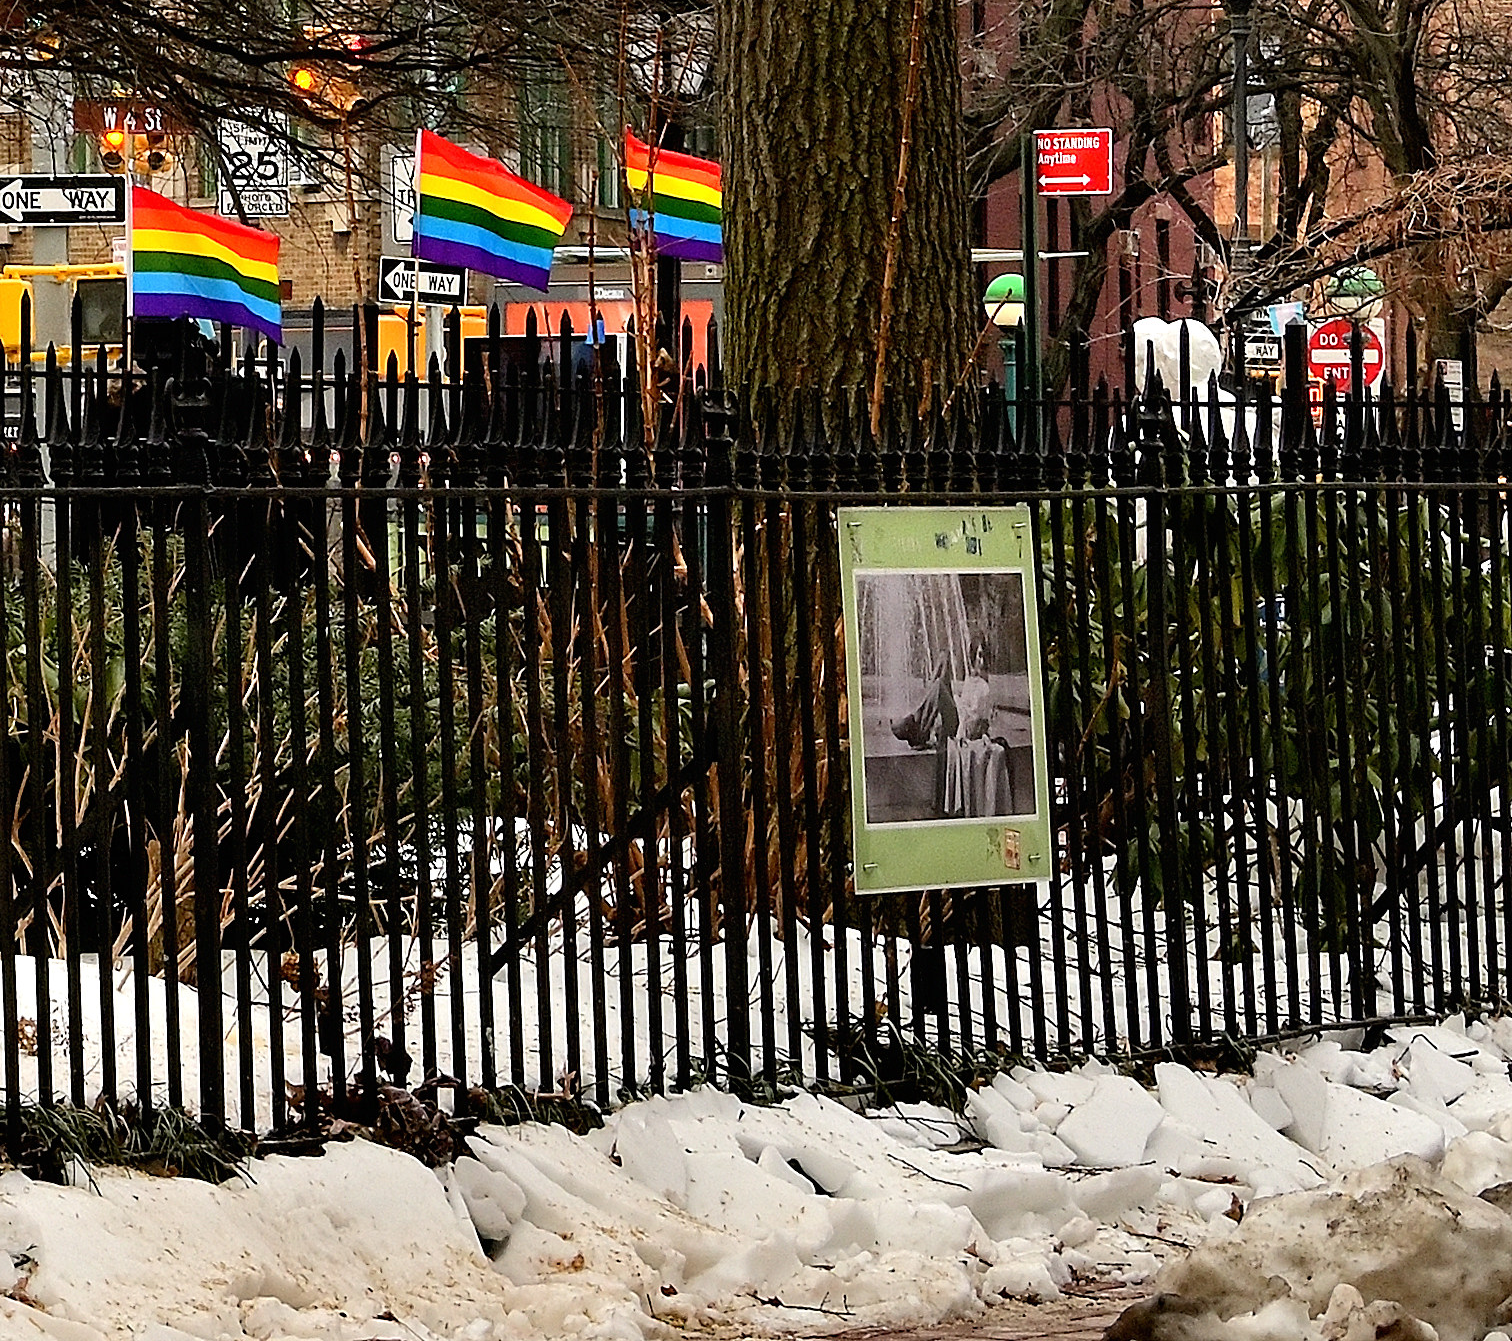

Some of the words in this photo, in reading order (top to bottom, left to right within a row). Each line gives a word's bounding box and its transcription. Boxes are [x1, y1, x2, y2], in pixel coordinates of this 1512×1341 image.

[103, 107, 117, 128] W
[1037, 137, 1051, 150] NO
[1053, 136, 1100, 150] STANDING
[230, 151, 279, 180] 25
[1037, 152, 1077, 167] Anytime
[2, 191, 42, 210] ONE
[66, 190, 110, 209] WAY
[393, 272, 415, 289] ONE
[428, 274, 455, 293] WAY
[1319, 333, 1338, 346] DO
